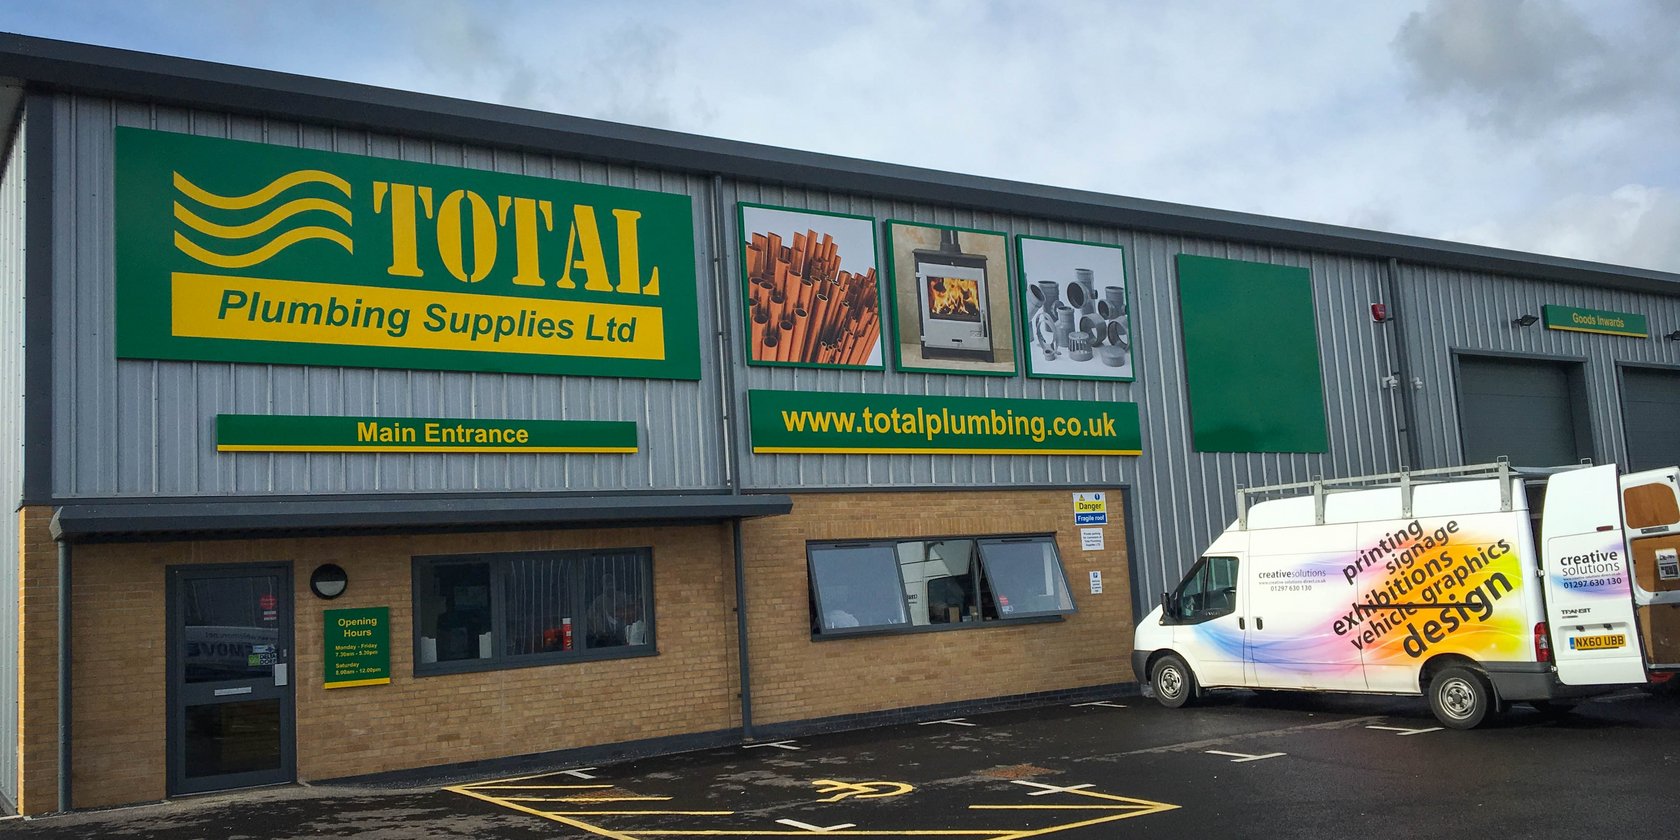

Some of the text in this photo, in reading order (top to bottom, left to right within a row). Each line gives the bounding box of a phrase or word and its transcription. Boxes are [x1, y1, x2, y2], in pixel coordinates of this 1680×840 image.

[373, 181, 660, 296] TOTAL
[217, 289, 637, 344] Plumbing Supplies Ltd
[1572, 313, 1624, 327] Goods Inwards
[357, 421, 529, 444] Main Entrance
[782, 406, 1117, 442] www.totalplumbing.co.uk
[1079, 502, 1102, 511] Danger
[1342, 519, 1424, 586] printing
[1386, 520, 1460, 575] signage
[1560, 549, 1618, 566] creative
[1258, 569, 1327, 579] creativesolutions
[1562, 562, 1620, 577] solutions
[1333, 550, 1454, 636] exhibitions
[1563, 577, 1622, 589] 01297 630 130
[1350, 538, 1511, 651] vehicle graphics
[1403, 571, 1513, 658] design
[1561, 607, 1592, 615] TRANSIT
[338, 617, 378, 627] Opening
[1575, 635, 1625, 648] NX60 UBB
